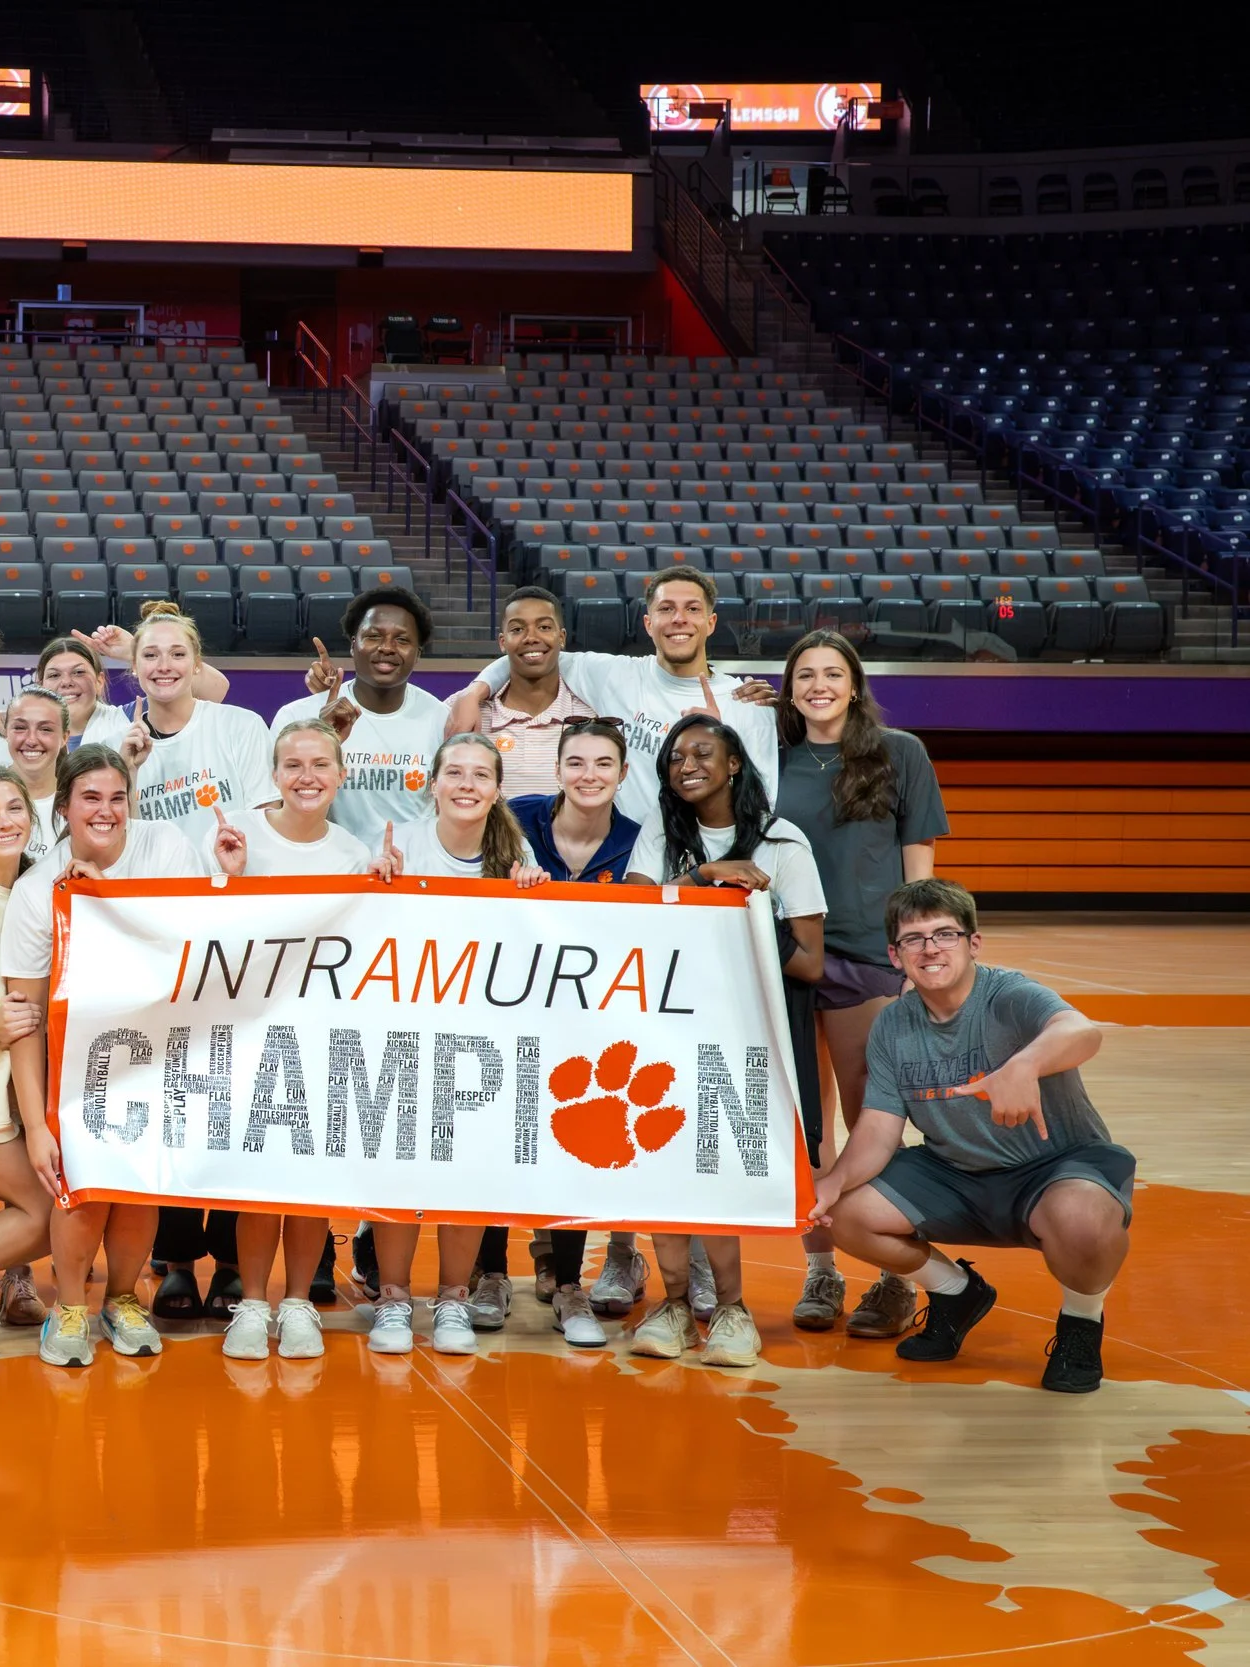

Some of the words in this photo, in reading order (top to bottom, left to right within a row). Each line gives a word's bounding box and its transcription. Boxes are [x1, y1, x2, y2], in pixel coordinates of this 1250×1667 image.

[730, 107, 800, 122] LEMSON
[630, 711, 668, 734] INTRA
[170, 936, 695, 1015] INTRAMURAL
[117, 1031, 143, 1039] EFFORT
[217, 1031, 227, 1047] FUN
[387, 1031, 420, 1040] COMPETE
[166, 1041, 189, 1050] FLAG
[387, 1039, 420, 1048] KICKBALL
[466, 1041, 495, 1049] FRISBEE
[131, 1048, 153, 1057] FLAG
[209, 1031, 217, 1075] DETERMINATION
[225, 1030, 233, 1076] SPORTSMANSHIP
[383, 1052, 419, 1060] VOLLEYBALL
[517, 1047, 540, 1058] FLAG
[171, 1058, 181, 1073] FUN
[217, 1047, 225, 1075] SOCCER
[350, 1058, 365, 1066] FUN
[399, 1060, 419, 1069] FLAG
[746, 1058, 768, 1068] FLAG
[164, 1059, 172, 1082] EFFORT
[259, 1063, 279, 1072] PLAY
[94, 1054, 111, 1110] VOLLEYBALL
[171, 1073, 209, 1082] SPIKEBALL
[328, 1076, 349, 1085] PLAY
[379, 1076, 395, 1084] PLAY
[698, 1077, 733, 1085] SPIKEBALL
[209, 1092, 232, 1101] FLAG
[253, 1094, 273, 1103] FLAG
[286, 1089, 306, 1099] FUN
[455, 1090, 496, 1102] RESPECT
[83, 1024, 769, 1178] CHAMPIN
[127, 1101, 150, 1109] TENNIS
[173, 1088, 186, 1116] PLAY
[397, 1105, 418, 1114] FLAG
[709, 1086, 719, 1133] VOLLEYBALL
[250, 1110, 293, 1120] BATTLESHIP
[293, 1112, 309, 1120] FUN
[208, 1121, 225, 1130] FUN
[291, 1121, 310, 1129] PLAY
[332, 1105, 341, 1143] SPIKEBALL
[431, 1125, 454, 1139] FUN
[732, 1126, 767, 1135] SOFTBALL
[243, 1142, 264, 1152] PLAY
[326, 1143, 346, 1153] FLAG
[522, 1128, 530, 1164] TEAMWORK
[697, 1139, 719, 1149] FLAG
[737, 1139, 768, 1149] EFFORT
